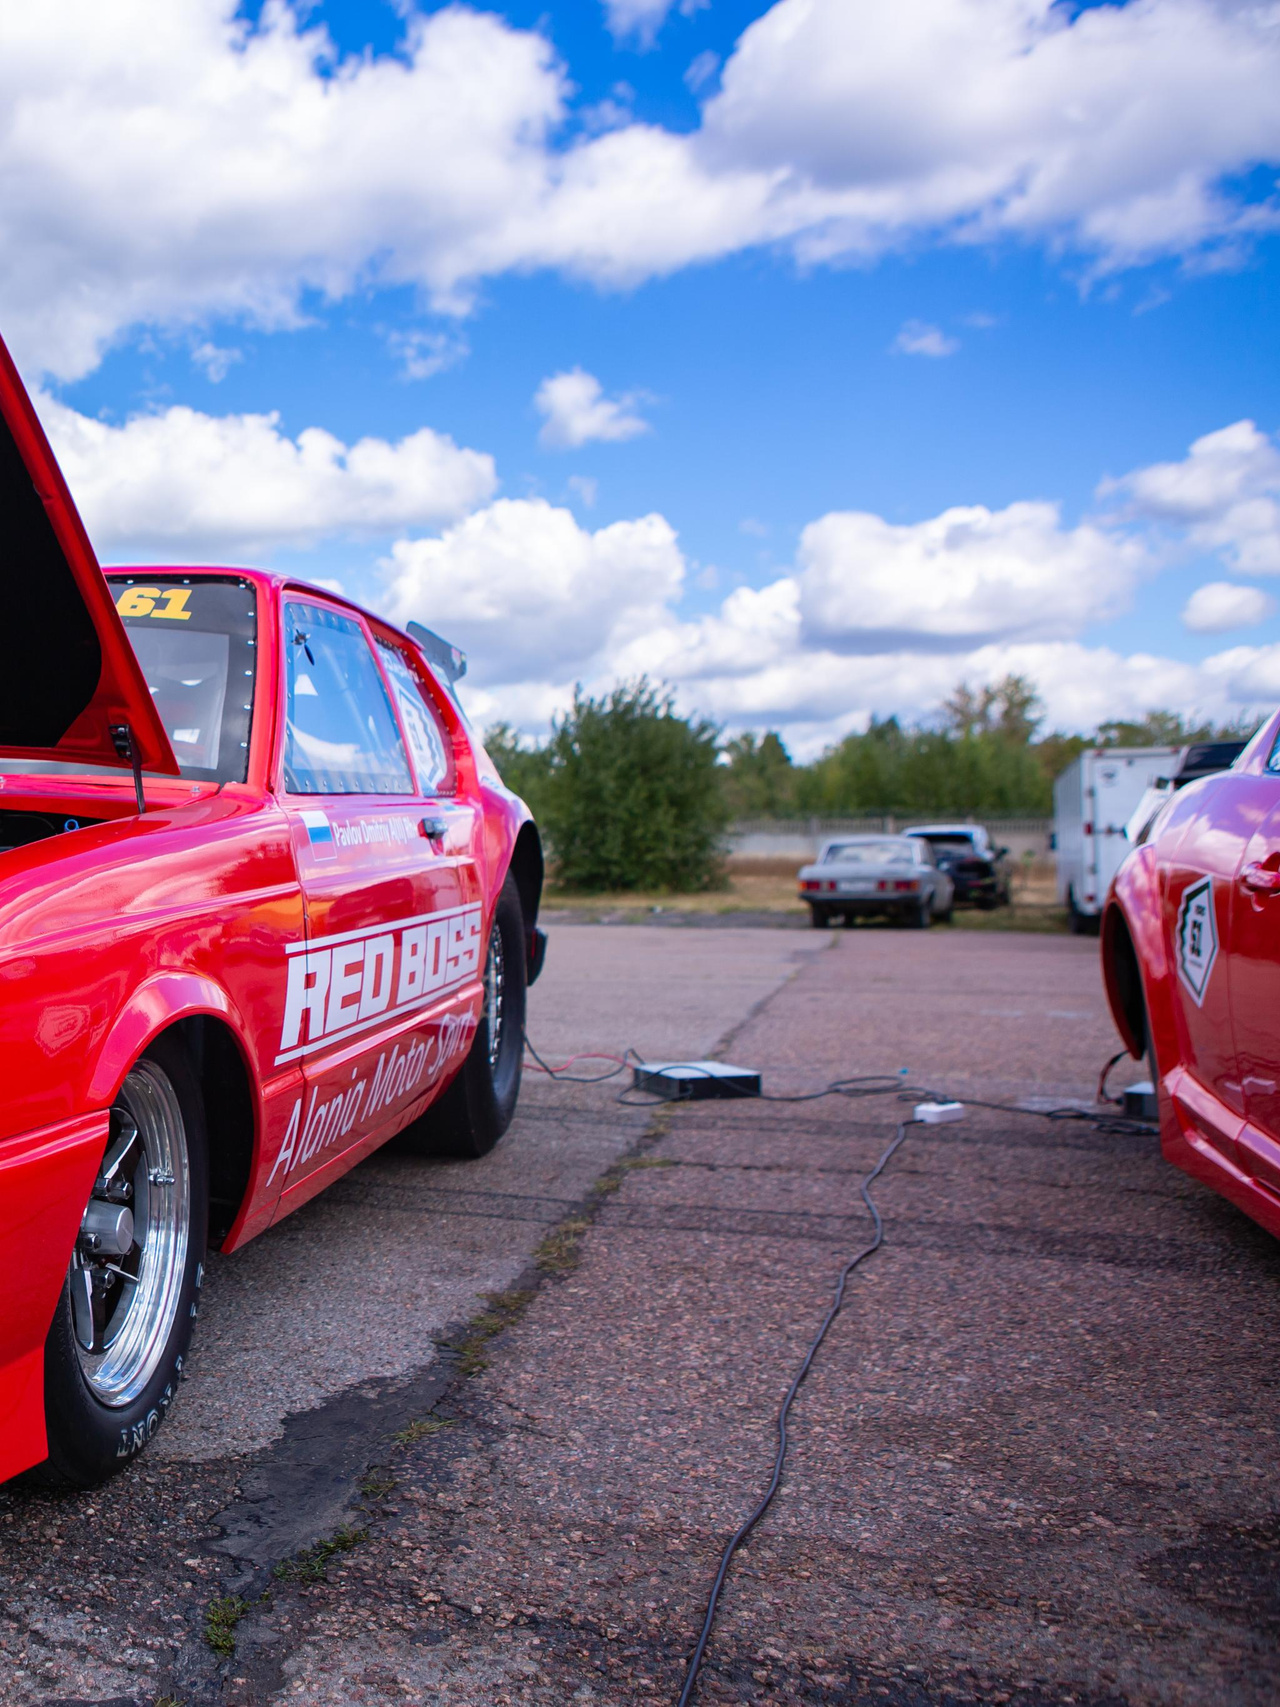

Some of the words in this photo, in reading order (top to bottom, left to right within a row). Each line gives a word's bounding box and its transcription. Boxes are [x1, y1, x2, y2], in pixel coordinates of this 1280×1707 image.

[116, 587, 192, 620] 61
[332, 819, 363, 847] Pavlov
[279, 933, 395, 1051] RED
[396, 912, 482, 1003] BOSS
[266, 1067, 365, 1187] Alania
[363, 1042, 429, 1122] Motor
